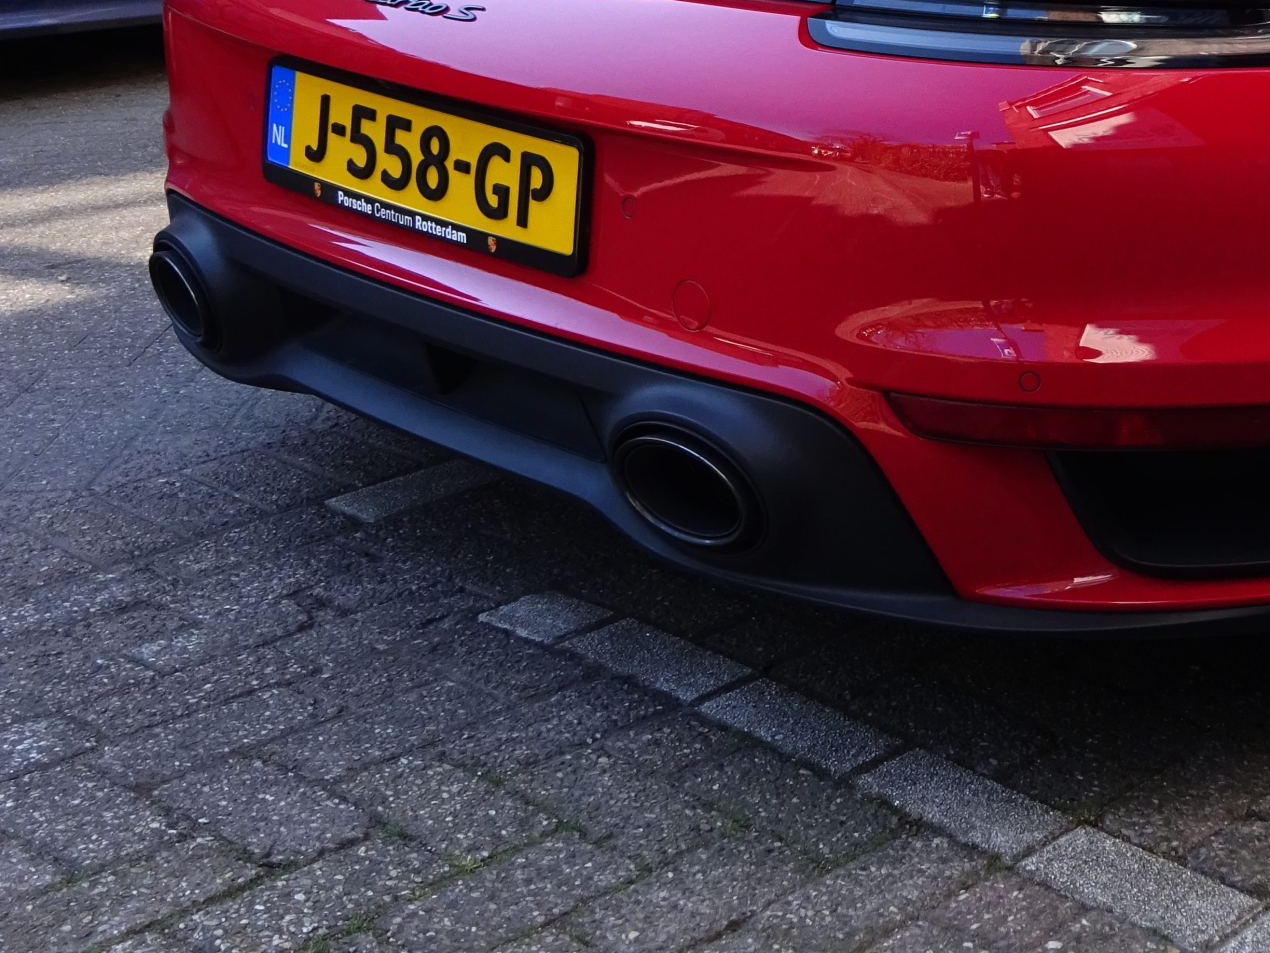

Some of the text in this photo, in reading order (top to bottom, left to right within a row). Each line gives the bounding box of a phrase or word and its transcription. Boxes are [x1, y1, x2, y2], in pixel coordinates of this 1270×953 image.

[442, 4, 486, 22] S
[271, 122, 289, 149] NL
[304, 93, 555, 230] J-558-GP
[337, 190, 467, 245] Porsche Centrum Rotterdam
